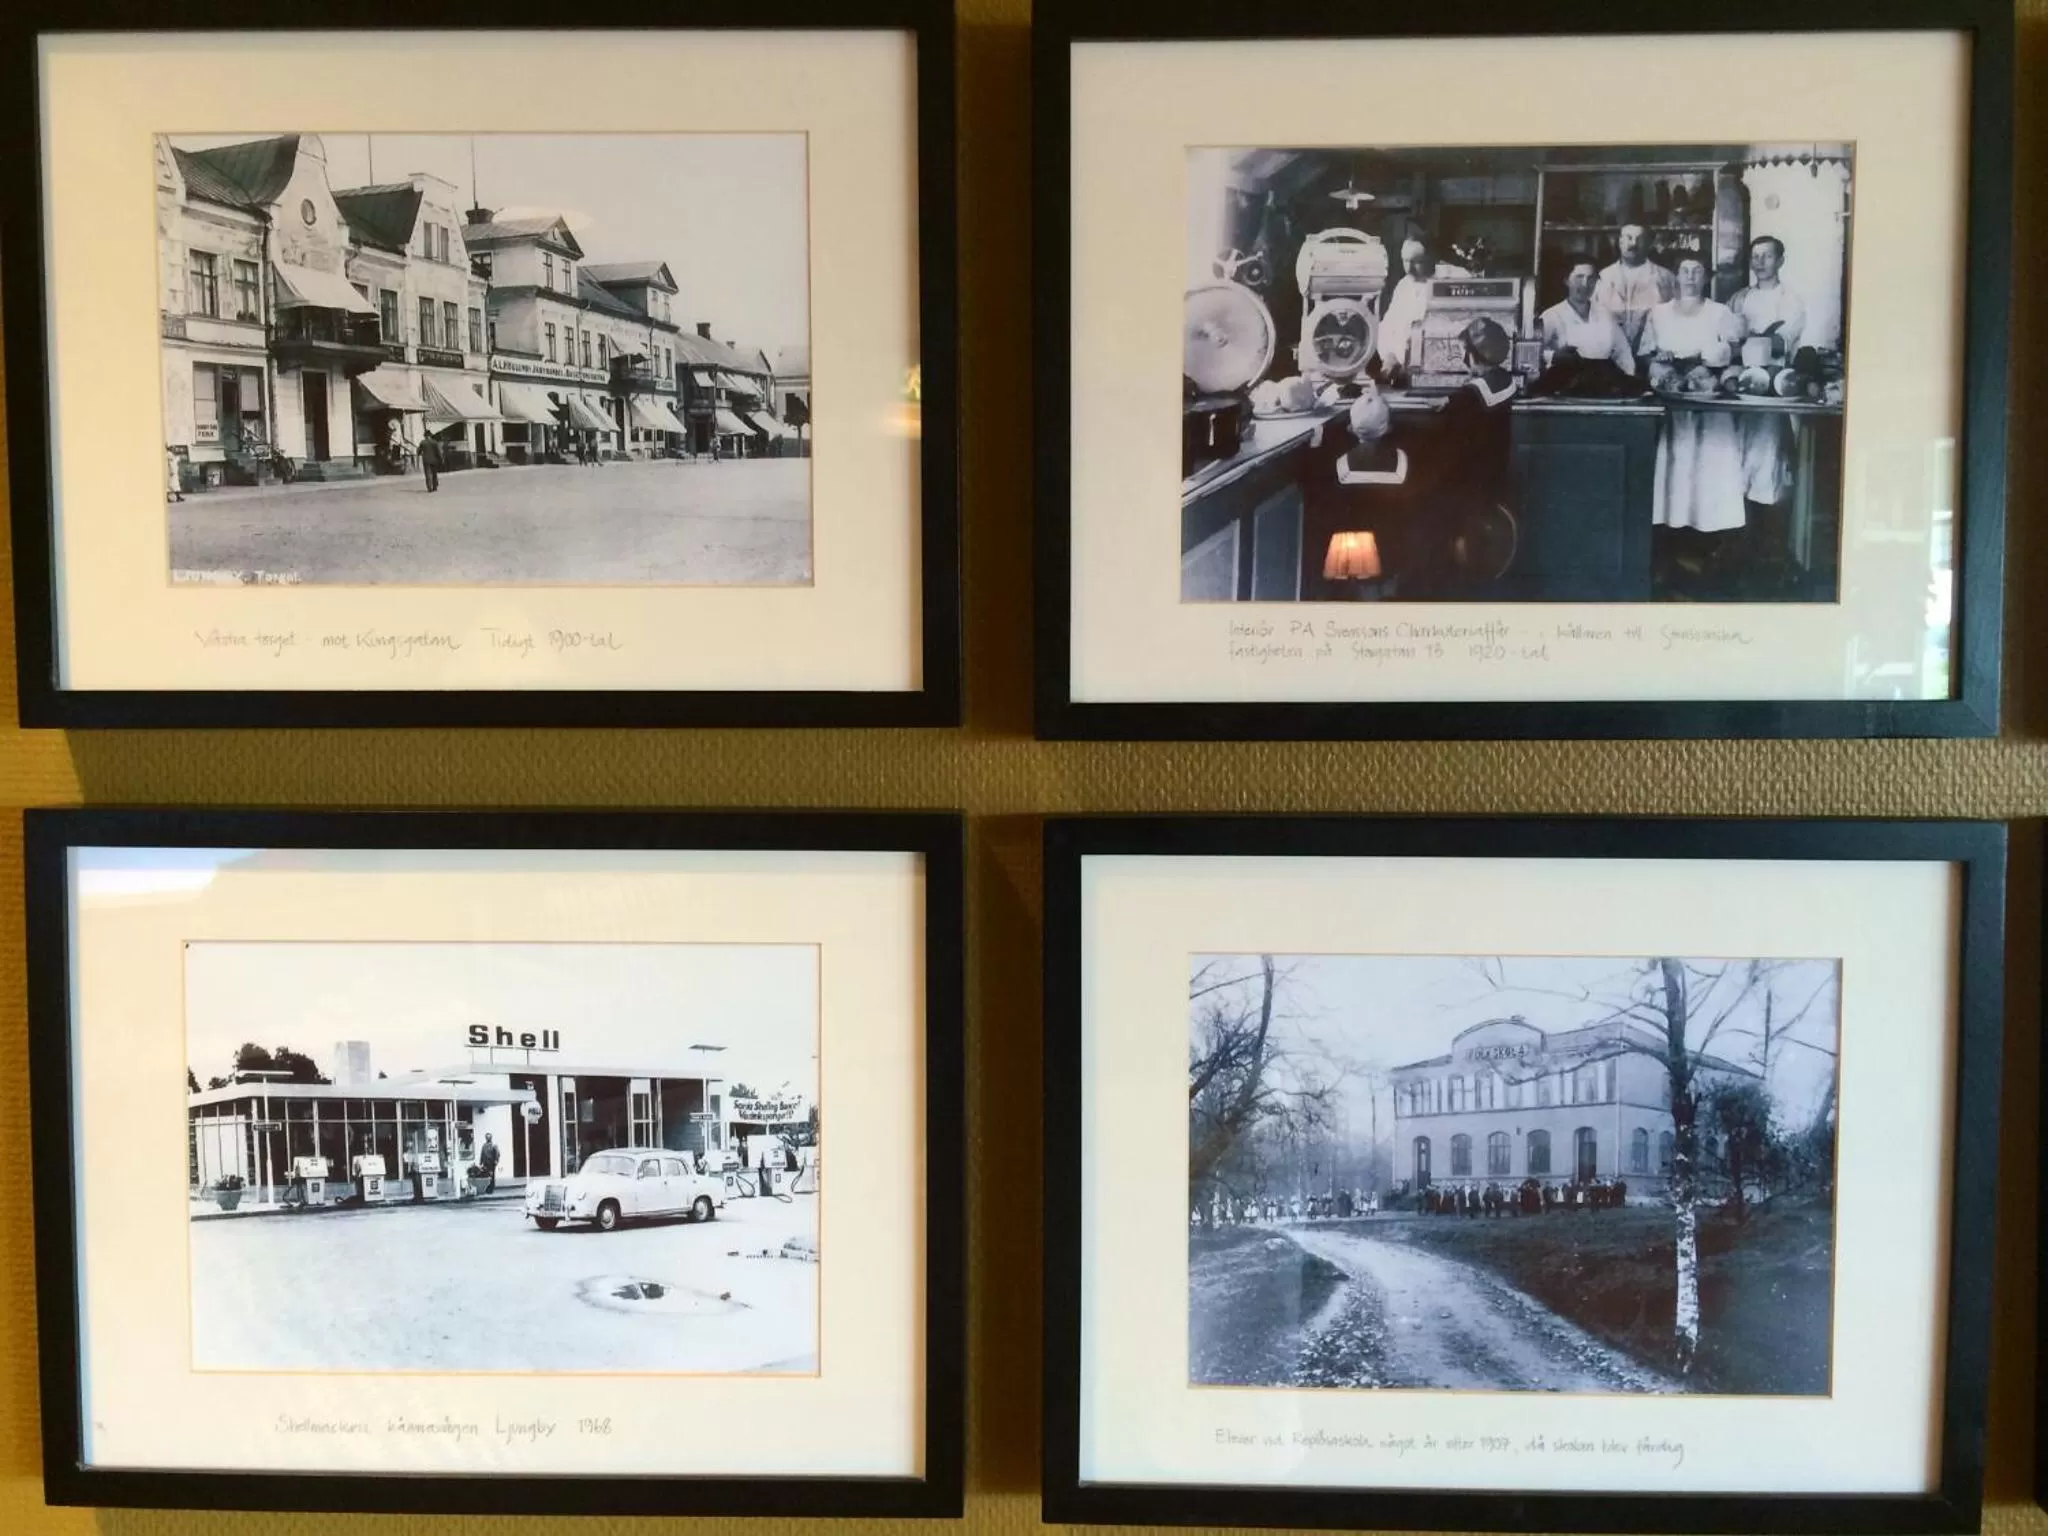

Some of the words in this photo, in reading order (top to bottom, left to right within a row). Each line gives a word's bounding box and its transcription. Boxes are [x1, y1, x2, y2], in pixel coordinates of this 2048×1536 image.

[468, 1024, 559, 1050] Shell
[495, 1409, 557, 1446] Ljungby
[578, 1416, 612, 1436] 1968
